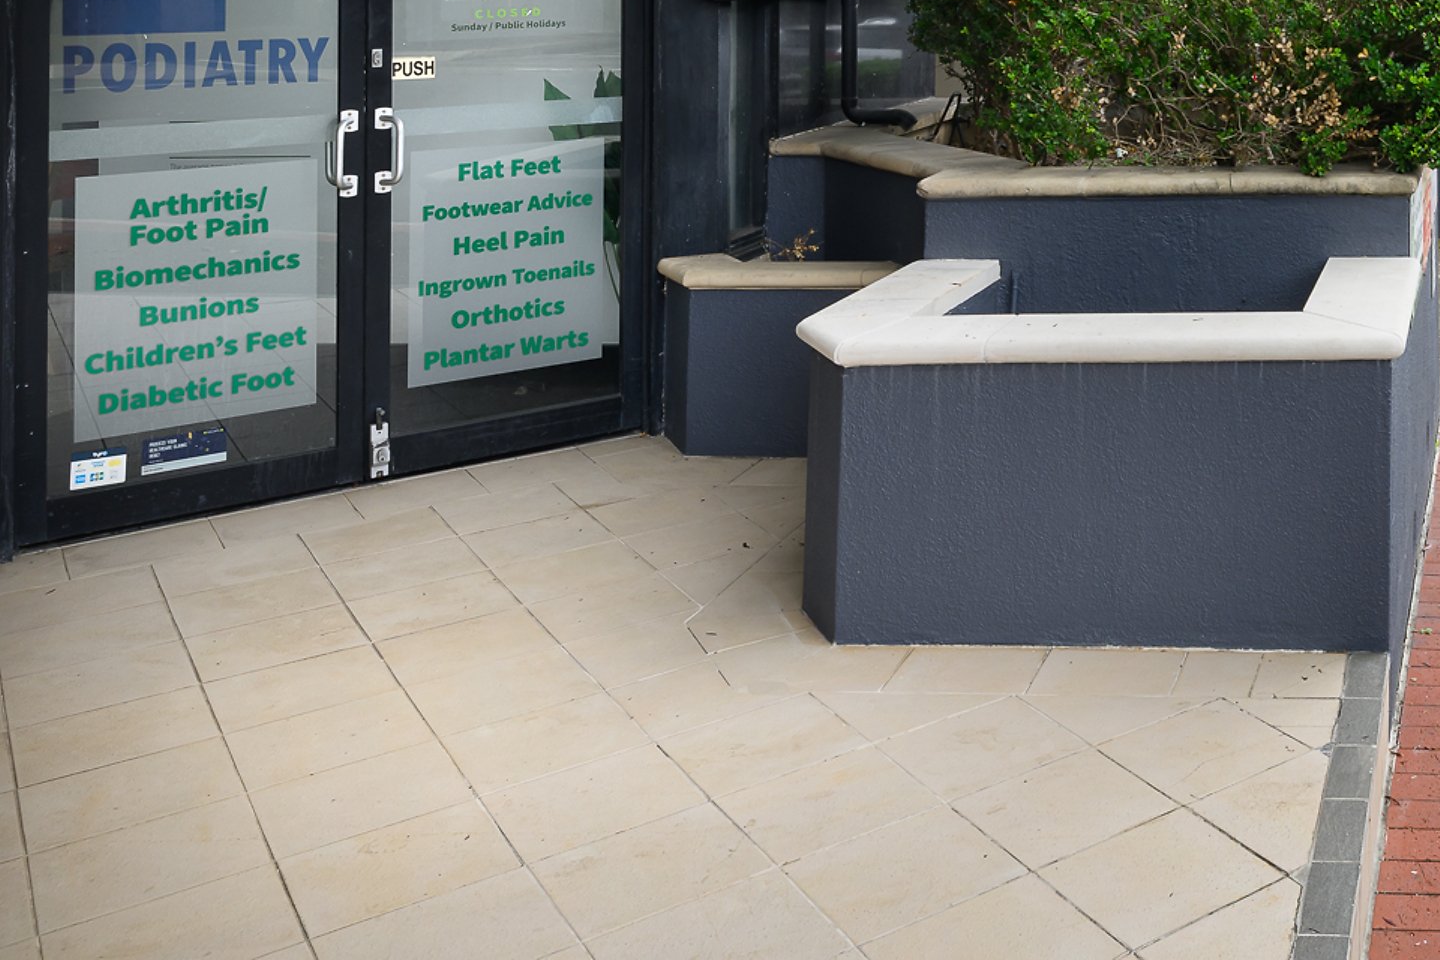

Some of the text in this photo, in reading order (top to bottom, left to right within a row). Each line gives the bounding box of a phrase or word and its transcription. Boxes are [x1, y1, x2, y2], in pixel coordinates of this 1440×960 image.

[451, 24, 488, 33] Sunday
[495, 21, 524, 30] Public
[526, 19, 566, 29] Holidays
[474, 7, 541, 19] CLOSED
[62, 36, 329, 94] PODIATRY
[393, 60, 434, 78] PUSH
[458, 156, 561, 182] Flat Feet
[130, 186, 268, 220] Arthritis/
[422, 191, 593, 222] Footwear Advice
[130, 213, 269, 247] Foot Pain
[453, 226, 565, 256] Heel Pain
[95, 250, 301, 292] Biomechanics
[418, 258, 596, 298] Ingrown Toenails
[139, 296, 260, 327] Bunions
[451, 296, 565, 330] Orthotics
[85, 326, 307, 375] Children's Feet
[424, 330, 590, 371] Plantar Warts
[99, 366, 295, 415] Diabetic Foot
